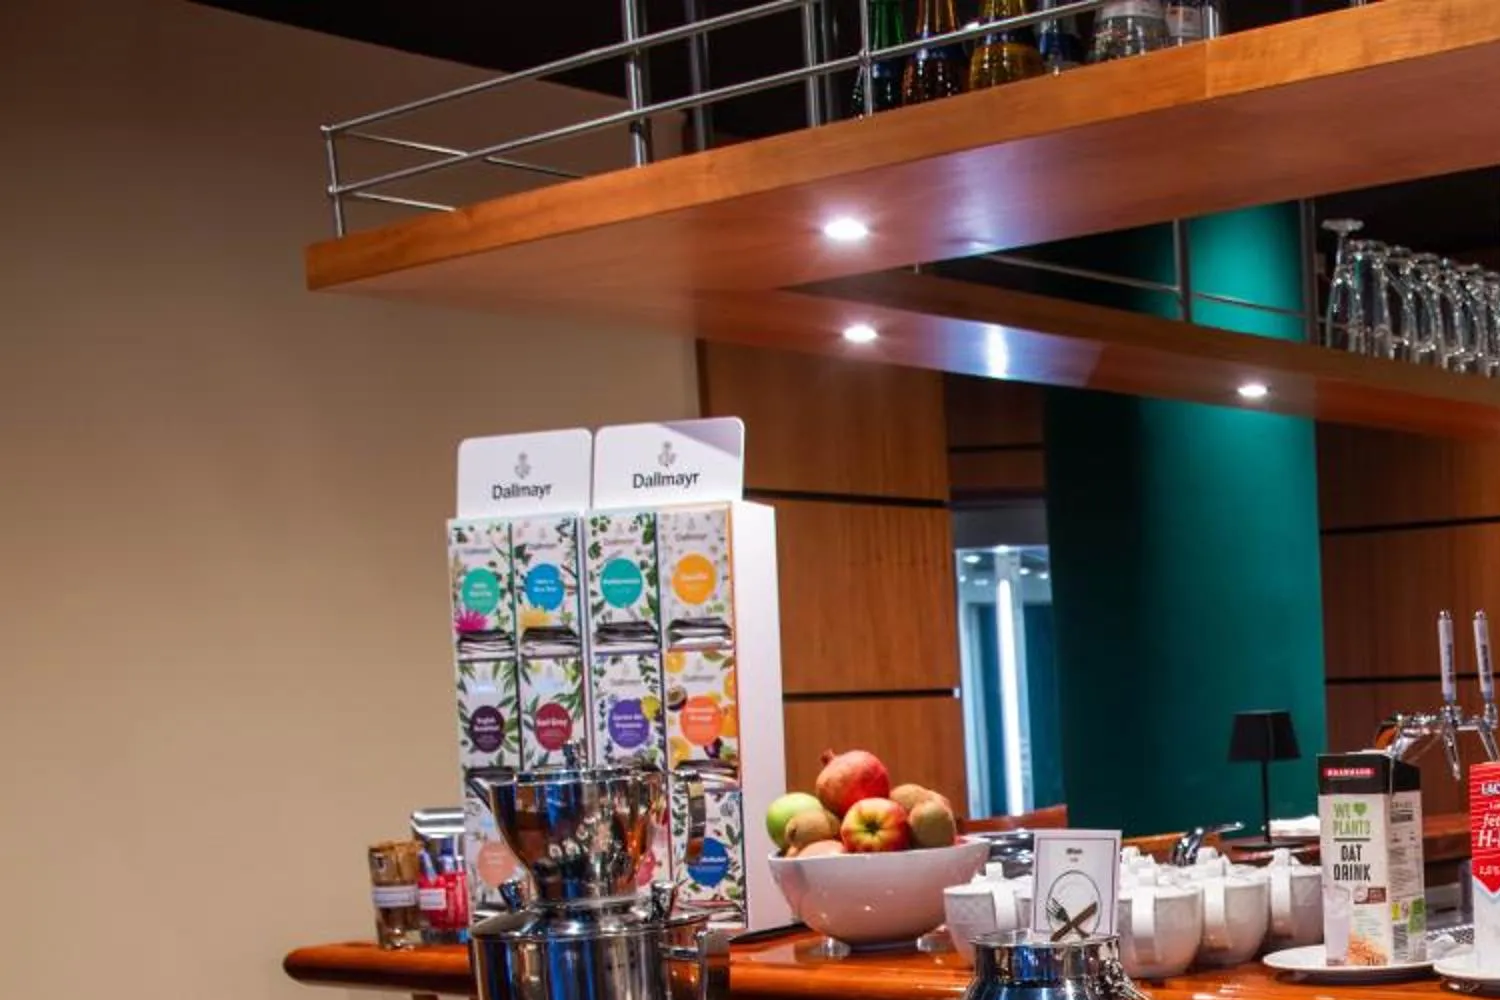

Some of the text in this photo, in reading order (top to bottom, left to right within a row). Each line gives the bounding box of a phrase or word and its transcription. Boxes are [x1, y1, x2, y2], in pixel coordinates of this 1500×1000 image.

[632, 471, 701, 491] Dallmayr
[492, 482, 552, 501] Dallmayr
[1340, 844, 1363, 861] OAT
[1333, 864, 1372, 881] DRINK
